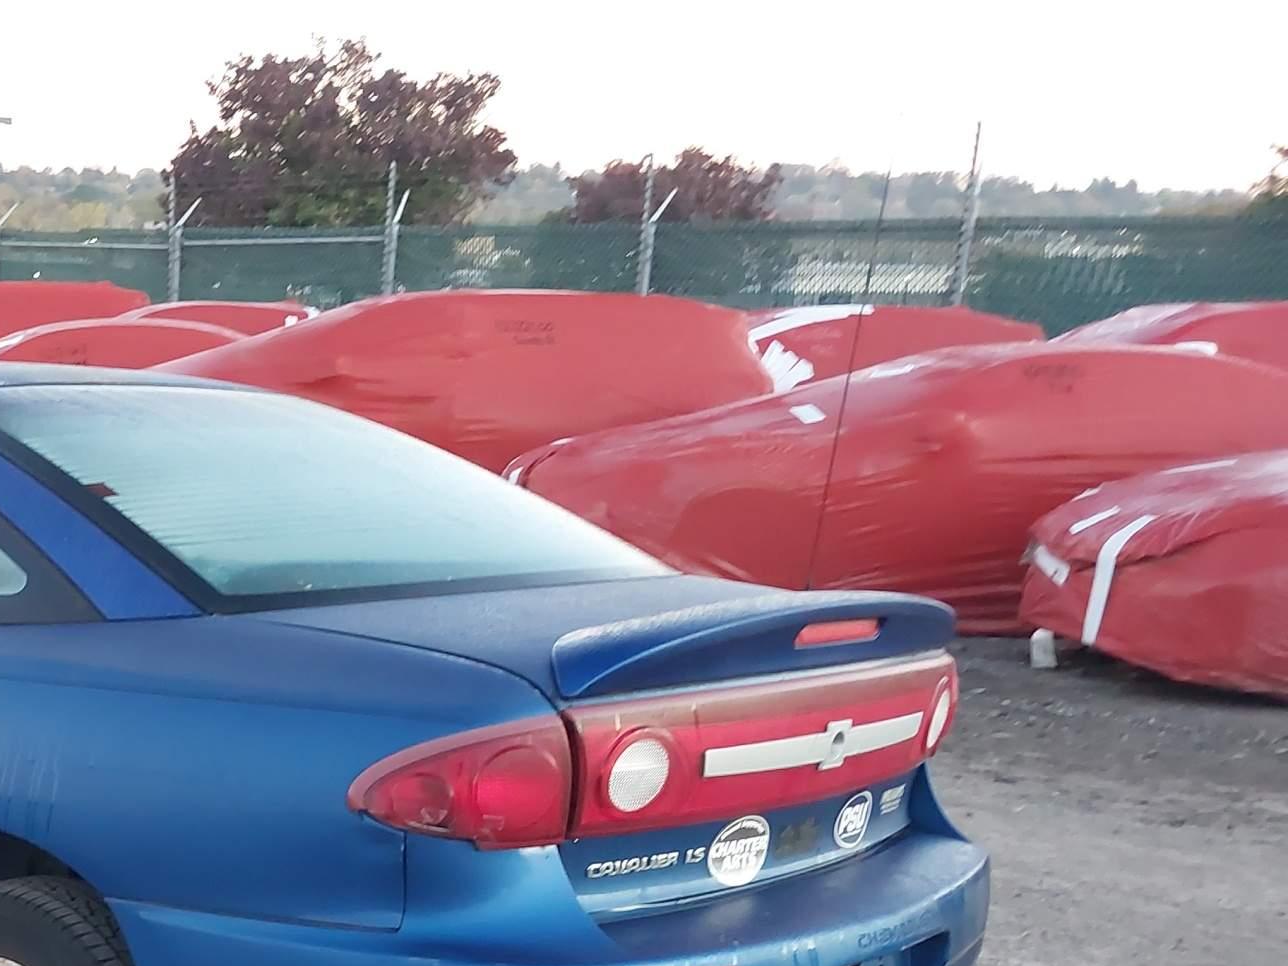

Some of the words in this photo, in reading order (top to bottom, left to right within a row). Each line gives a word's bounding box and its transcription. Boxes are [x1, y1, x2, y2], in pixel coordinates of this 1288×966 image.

[838, 801, 869, 836] PSU
[585, 850, 680, 879] CAVALIER
[684, 846, 706, 865] LS
